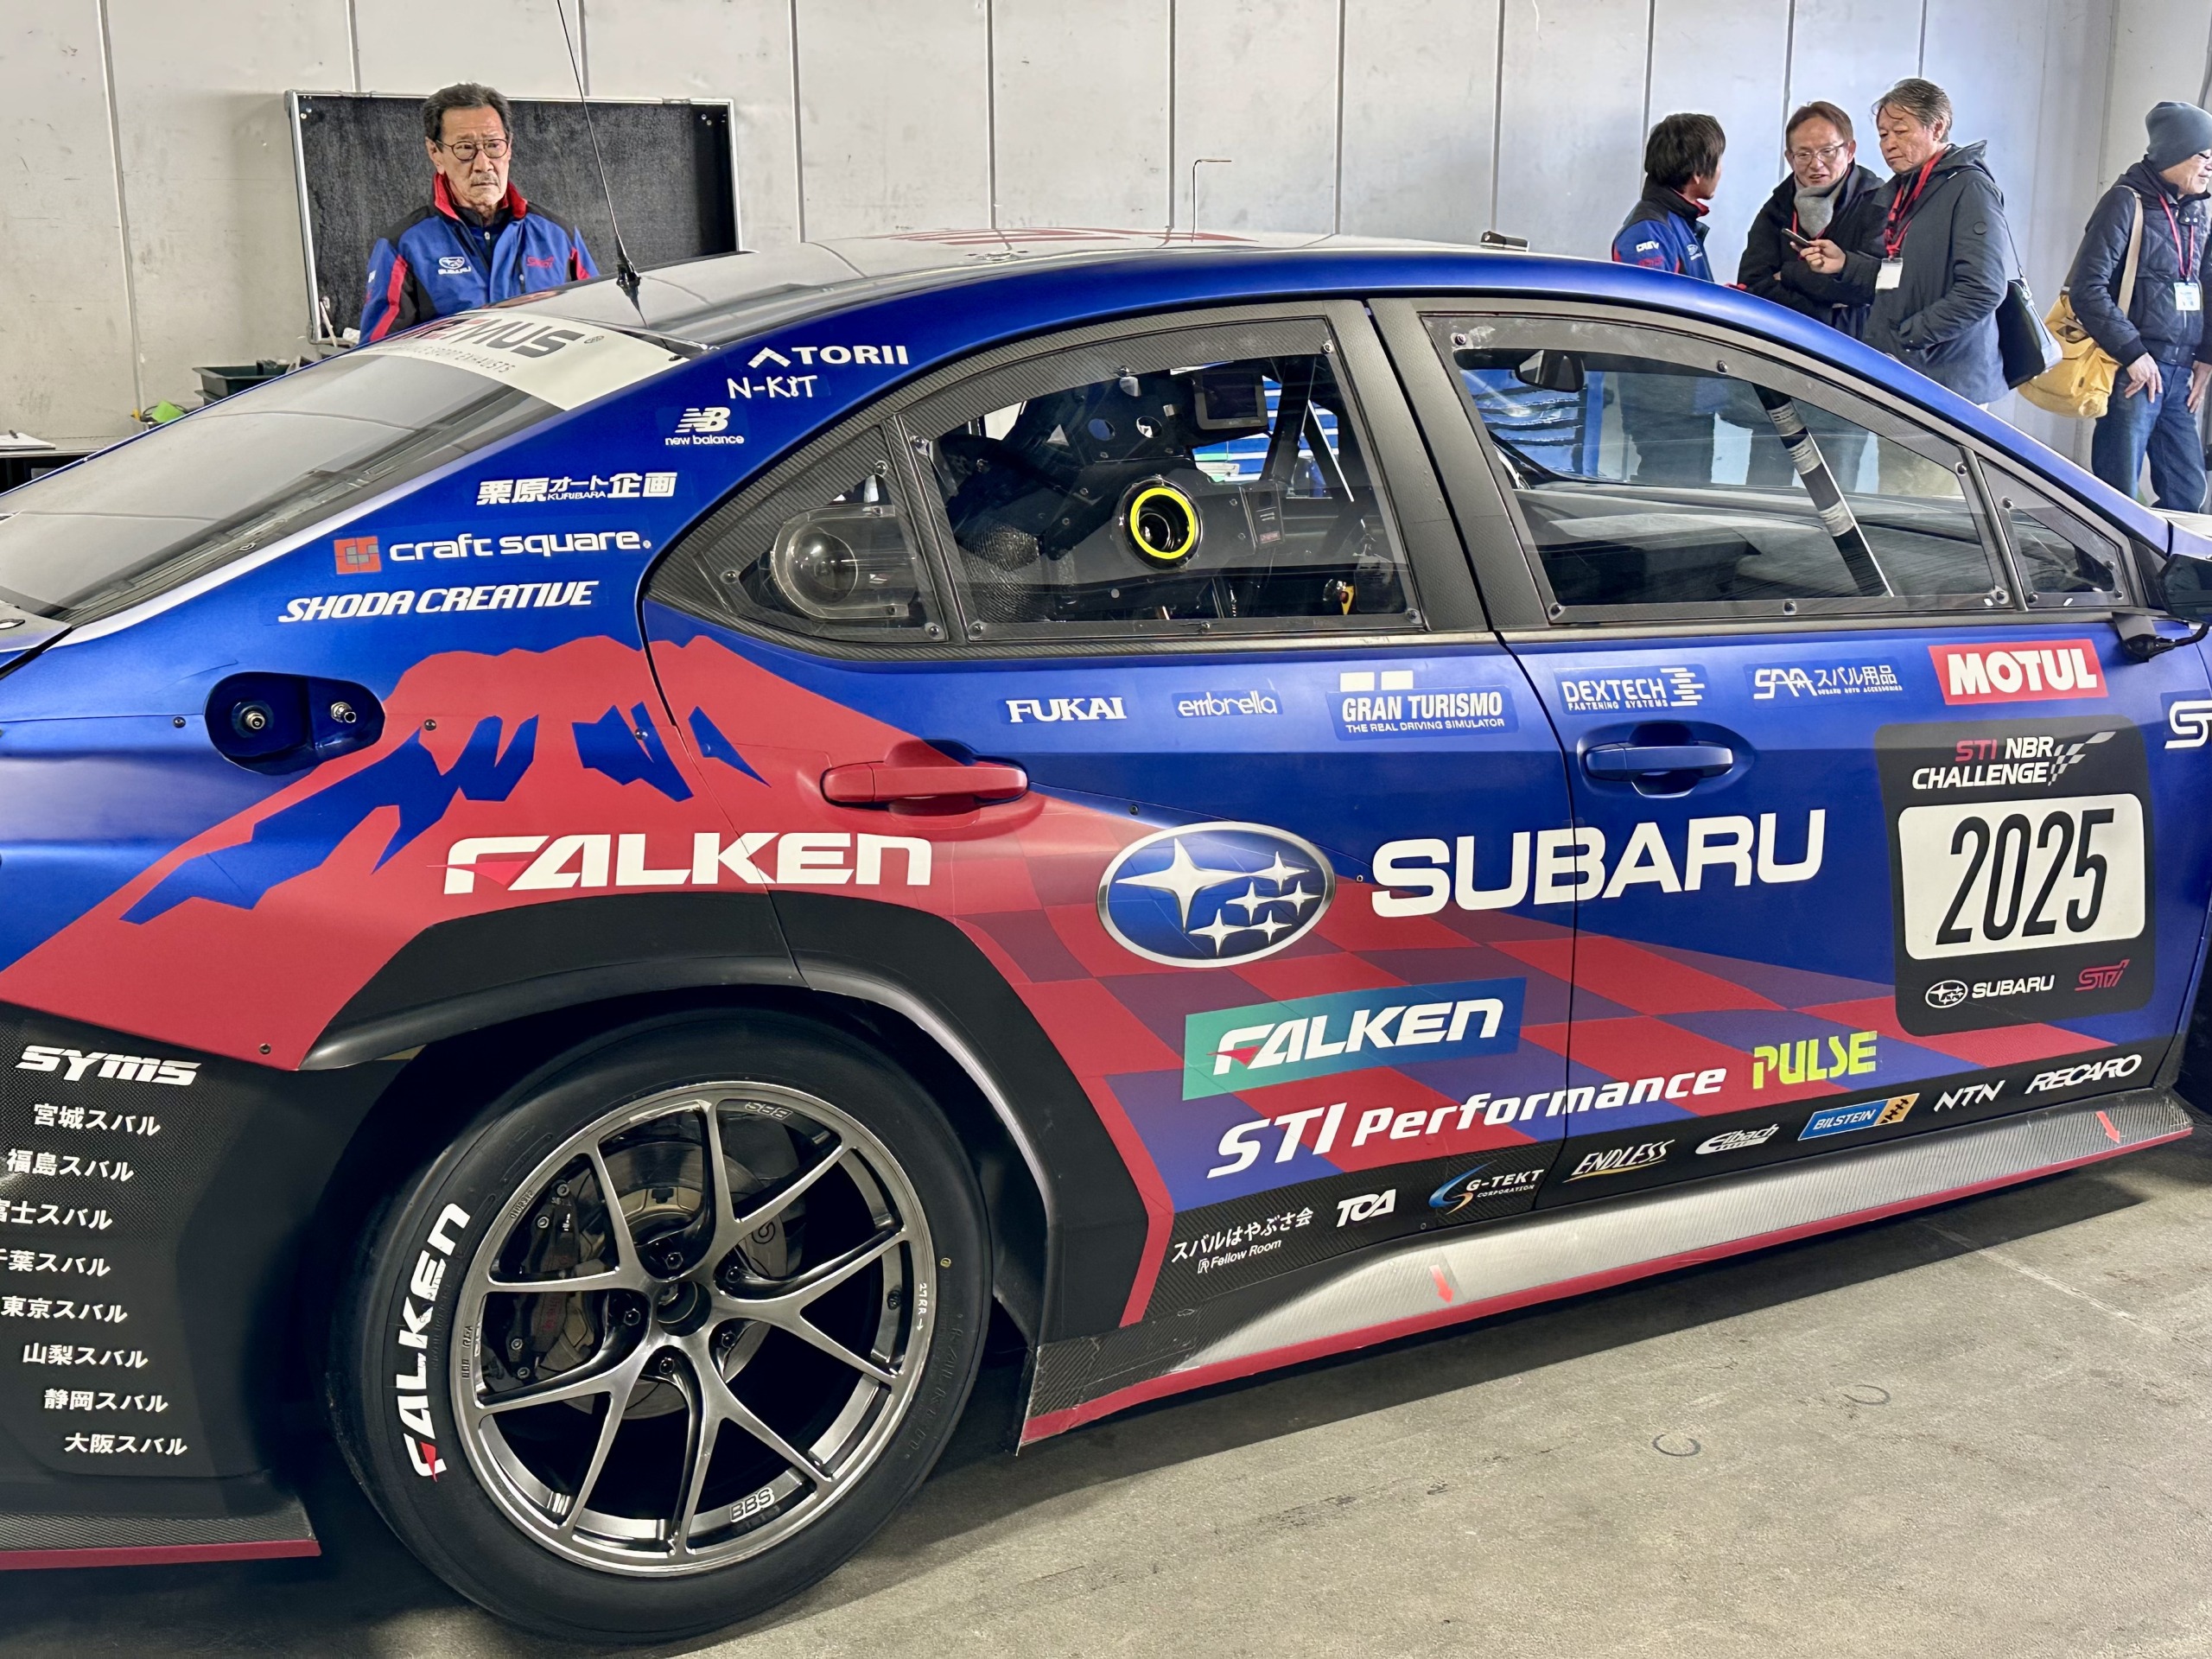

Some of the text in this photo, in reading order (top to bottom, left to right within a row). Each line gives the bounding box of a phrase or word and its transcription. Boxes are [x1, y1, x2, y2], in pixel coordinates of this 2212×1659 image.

[791, 345, 909, 365] TORII
[664, 434, 744, 446] new balance
[547, 490, 607, 501] KURIBARA
[389, 533, 495, 562] craft
[278, 581, 600, 623] SHODA CREATIVE
[1816, 664, 1898, 687] スバル用品
[1946, 646, 2098, 696] MOTUL
[1178, 690, 1278, 717] embrella
[1561, 677, 1664, 702] DEXTECH
[1005, 696, 1127, 723] FUKAI
[1342, 691, 1503, 722] GRAN TURISMO
[1567, 699, 1669, 710] FASTENING SYSTEMS
[1345, 718, 1505, 734] THE REAL DRIVING SIMULATOR
[1955, 735, 2055, 762] STI NBR
[1912, 761, 2050, 790] CHALLENGE
[443, 831, 932, 894] FALKEN
[1372, 809, 1825, 918] SUBARU
[1936, 808, 2114, 945] 2025
[1972, 975, 2056, 999] SUBARU
[1212, 997, 1505, 1076] FALKEN
[1751, 1030, 1879, 1090] PULSE
[2024, 1053, 2143, 1095] RECARO
[1934, 1079, 2005, 1113] NTN
[33, 1103, 162, 1136] 宮城スバル
[1206, 1068, 1728, 1179] STI Performance
[1813, 1109, 1878, 1131] BILSTEIN
[1694, 1123, 1780, 1155] Eibach
[6, 1148, 135, 1183] 福島スバル
[1572, 1139, 1675, 1176] ENDLESS
[1465, 1169, 1544, 1192] G-TEKT
[1477, 1185, 1535, 1198] CORPORATION
[1337, 1188, 1397, 1228] TOA
[1172, 1206, 1314, 1263] スバルはやぶさ会
[1211, 1239, 1281, 1269] Fellow Room
[0, 1295, 129, 1324] 東京スバル
[396, 1203, 471, 1478] FALKEN
[22, 1342, 149, 1369] 山梨スバル
[44, 1388, 168, 1414] 静岡スバル
[64, 1432, 188, 1457] 大阪スバル
[730, 1487, 775, 1523] BBS
